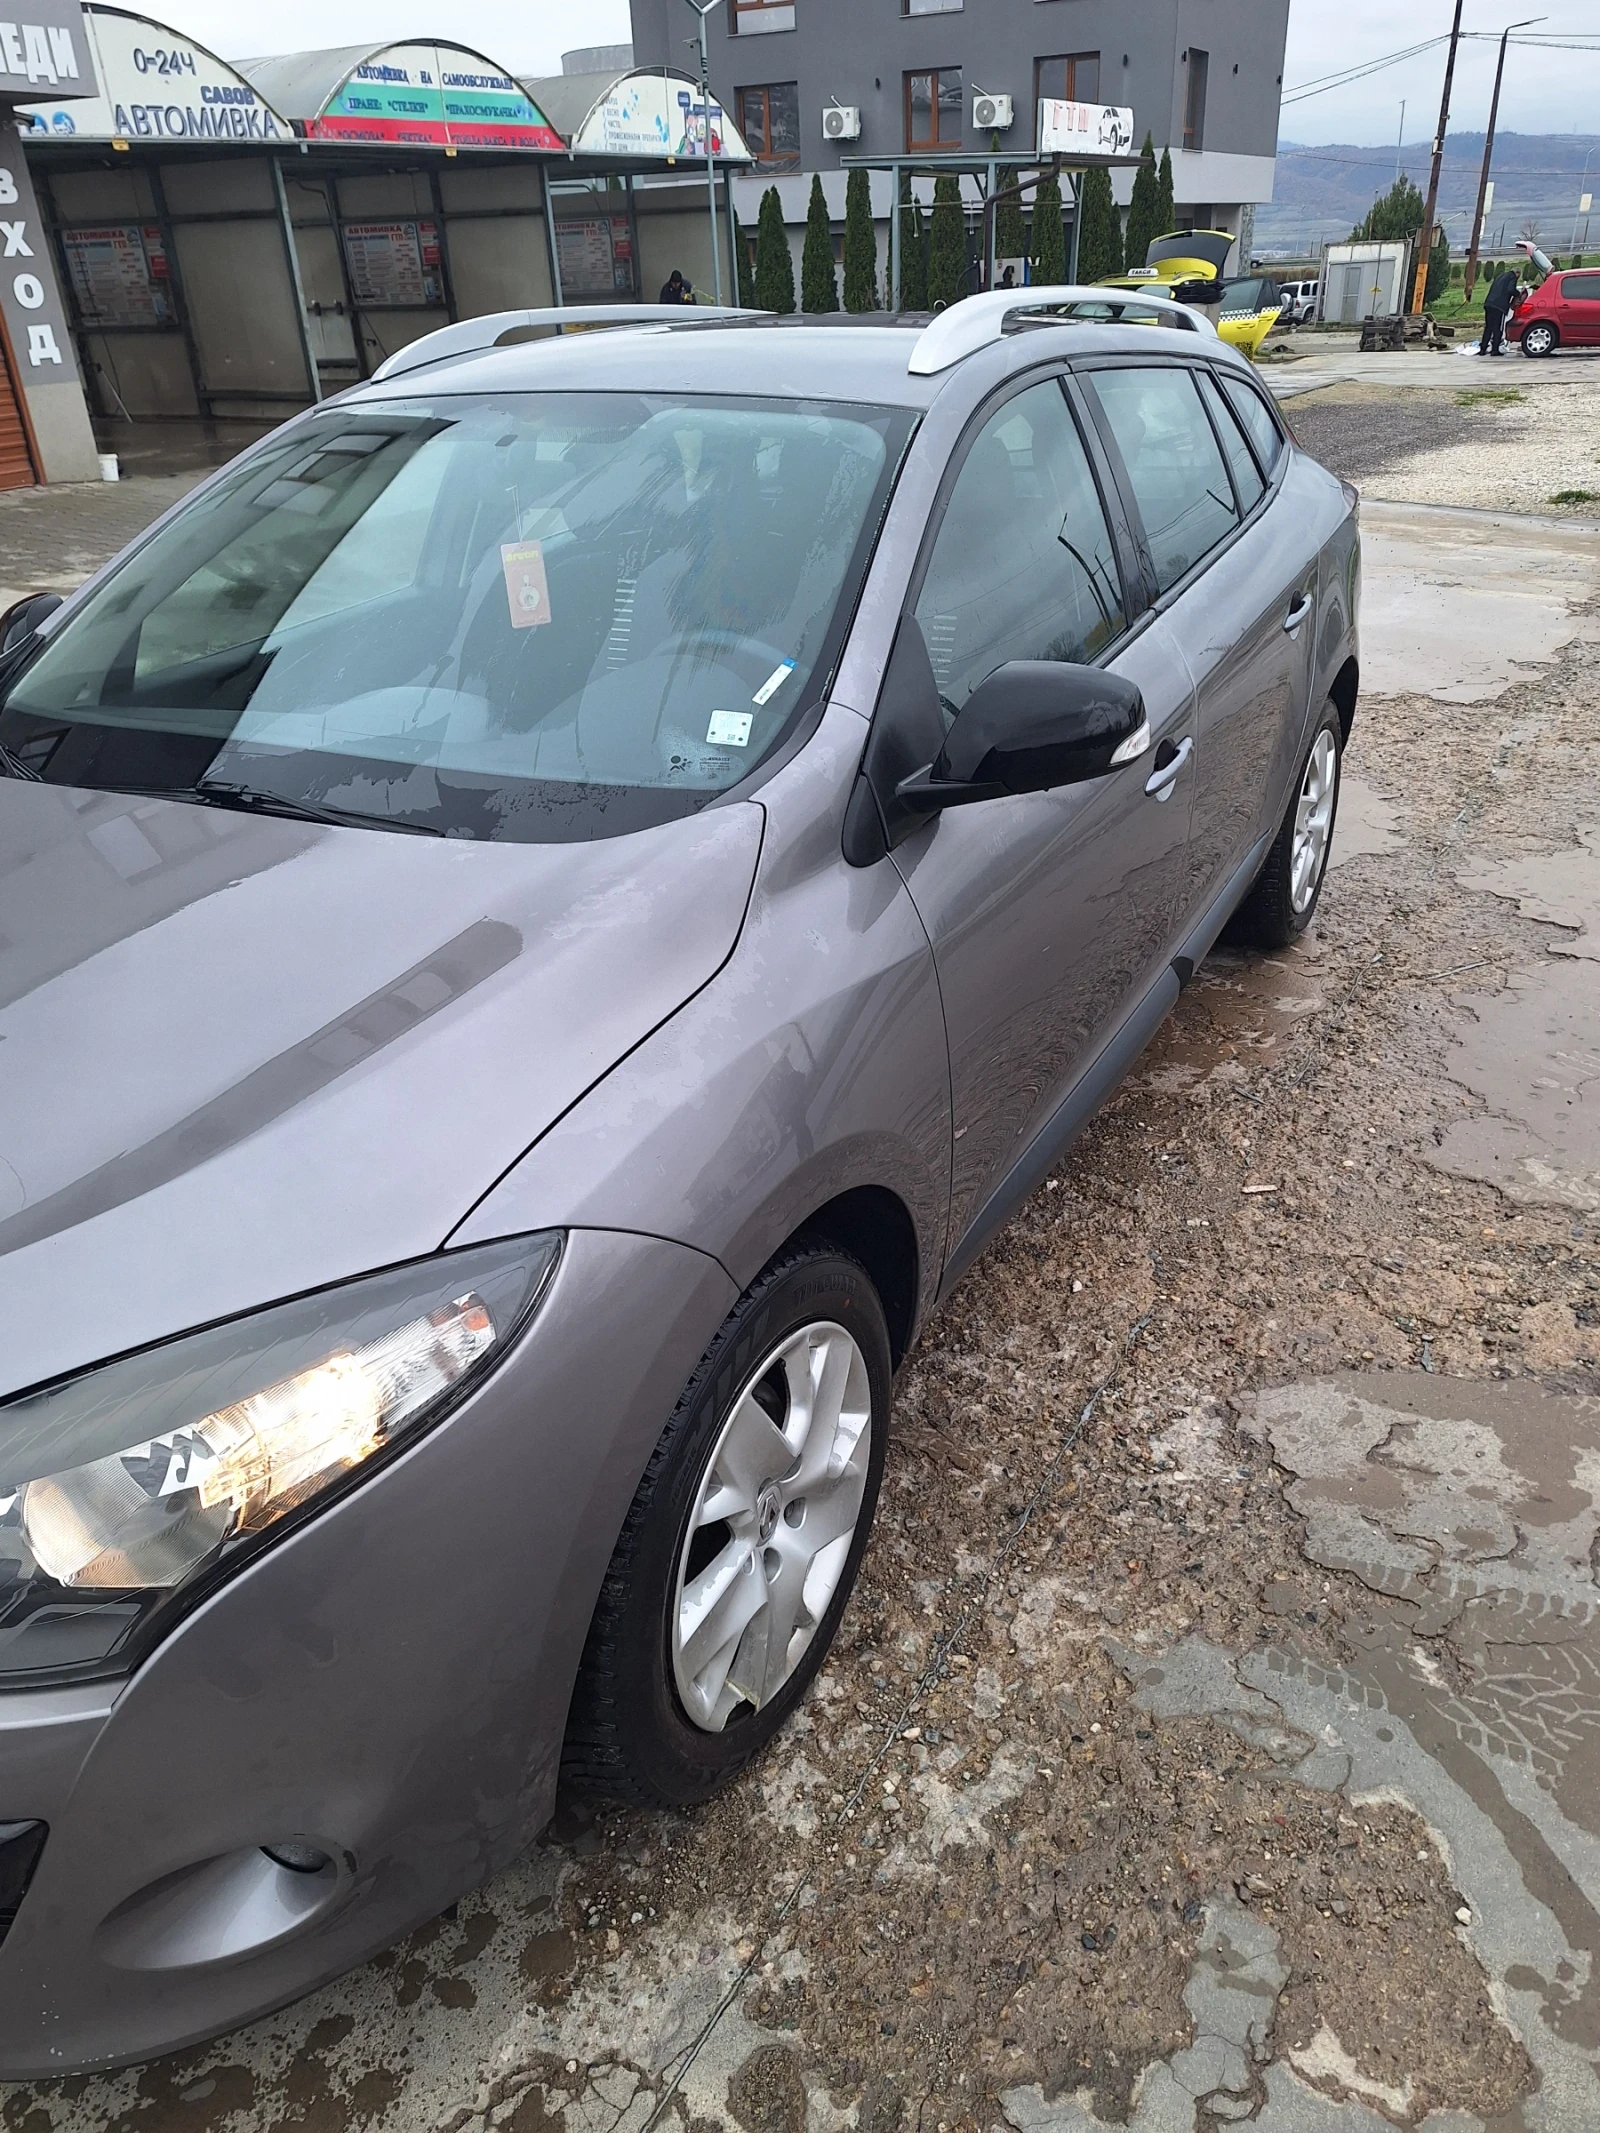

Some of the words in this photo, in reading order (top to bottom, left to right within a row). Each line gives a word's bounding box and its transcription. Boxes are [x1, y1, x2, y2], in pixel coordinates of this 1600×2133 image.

[357, 66, 410, 84] АВТОМИВКА
[420, 71, 433, 84] НА
[200, 86, 255, 105] САВОВ
[115, 104, 281, 138] АВТОМИВКА
[0, 167, 62, 366] ВХОД
